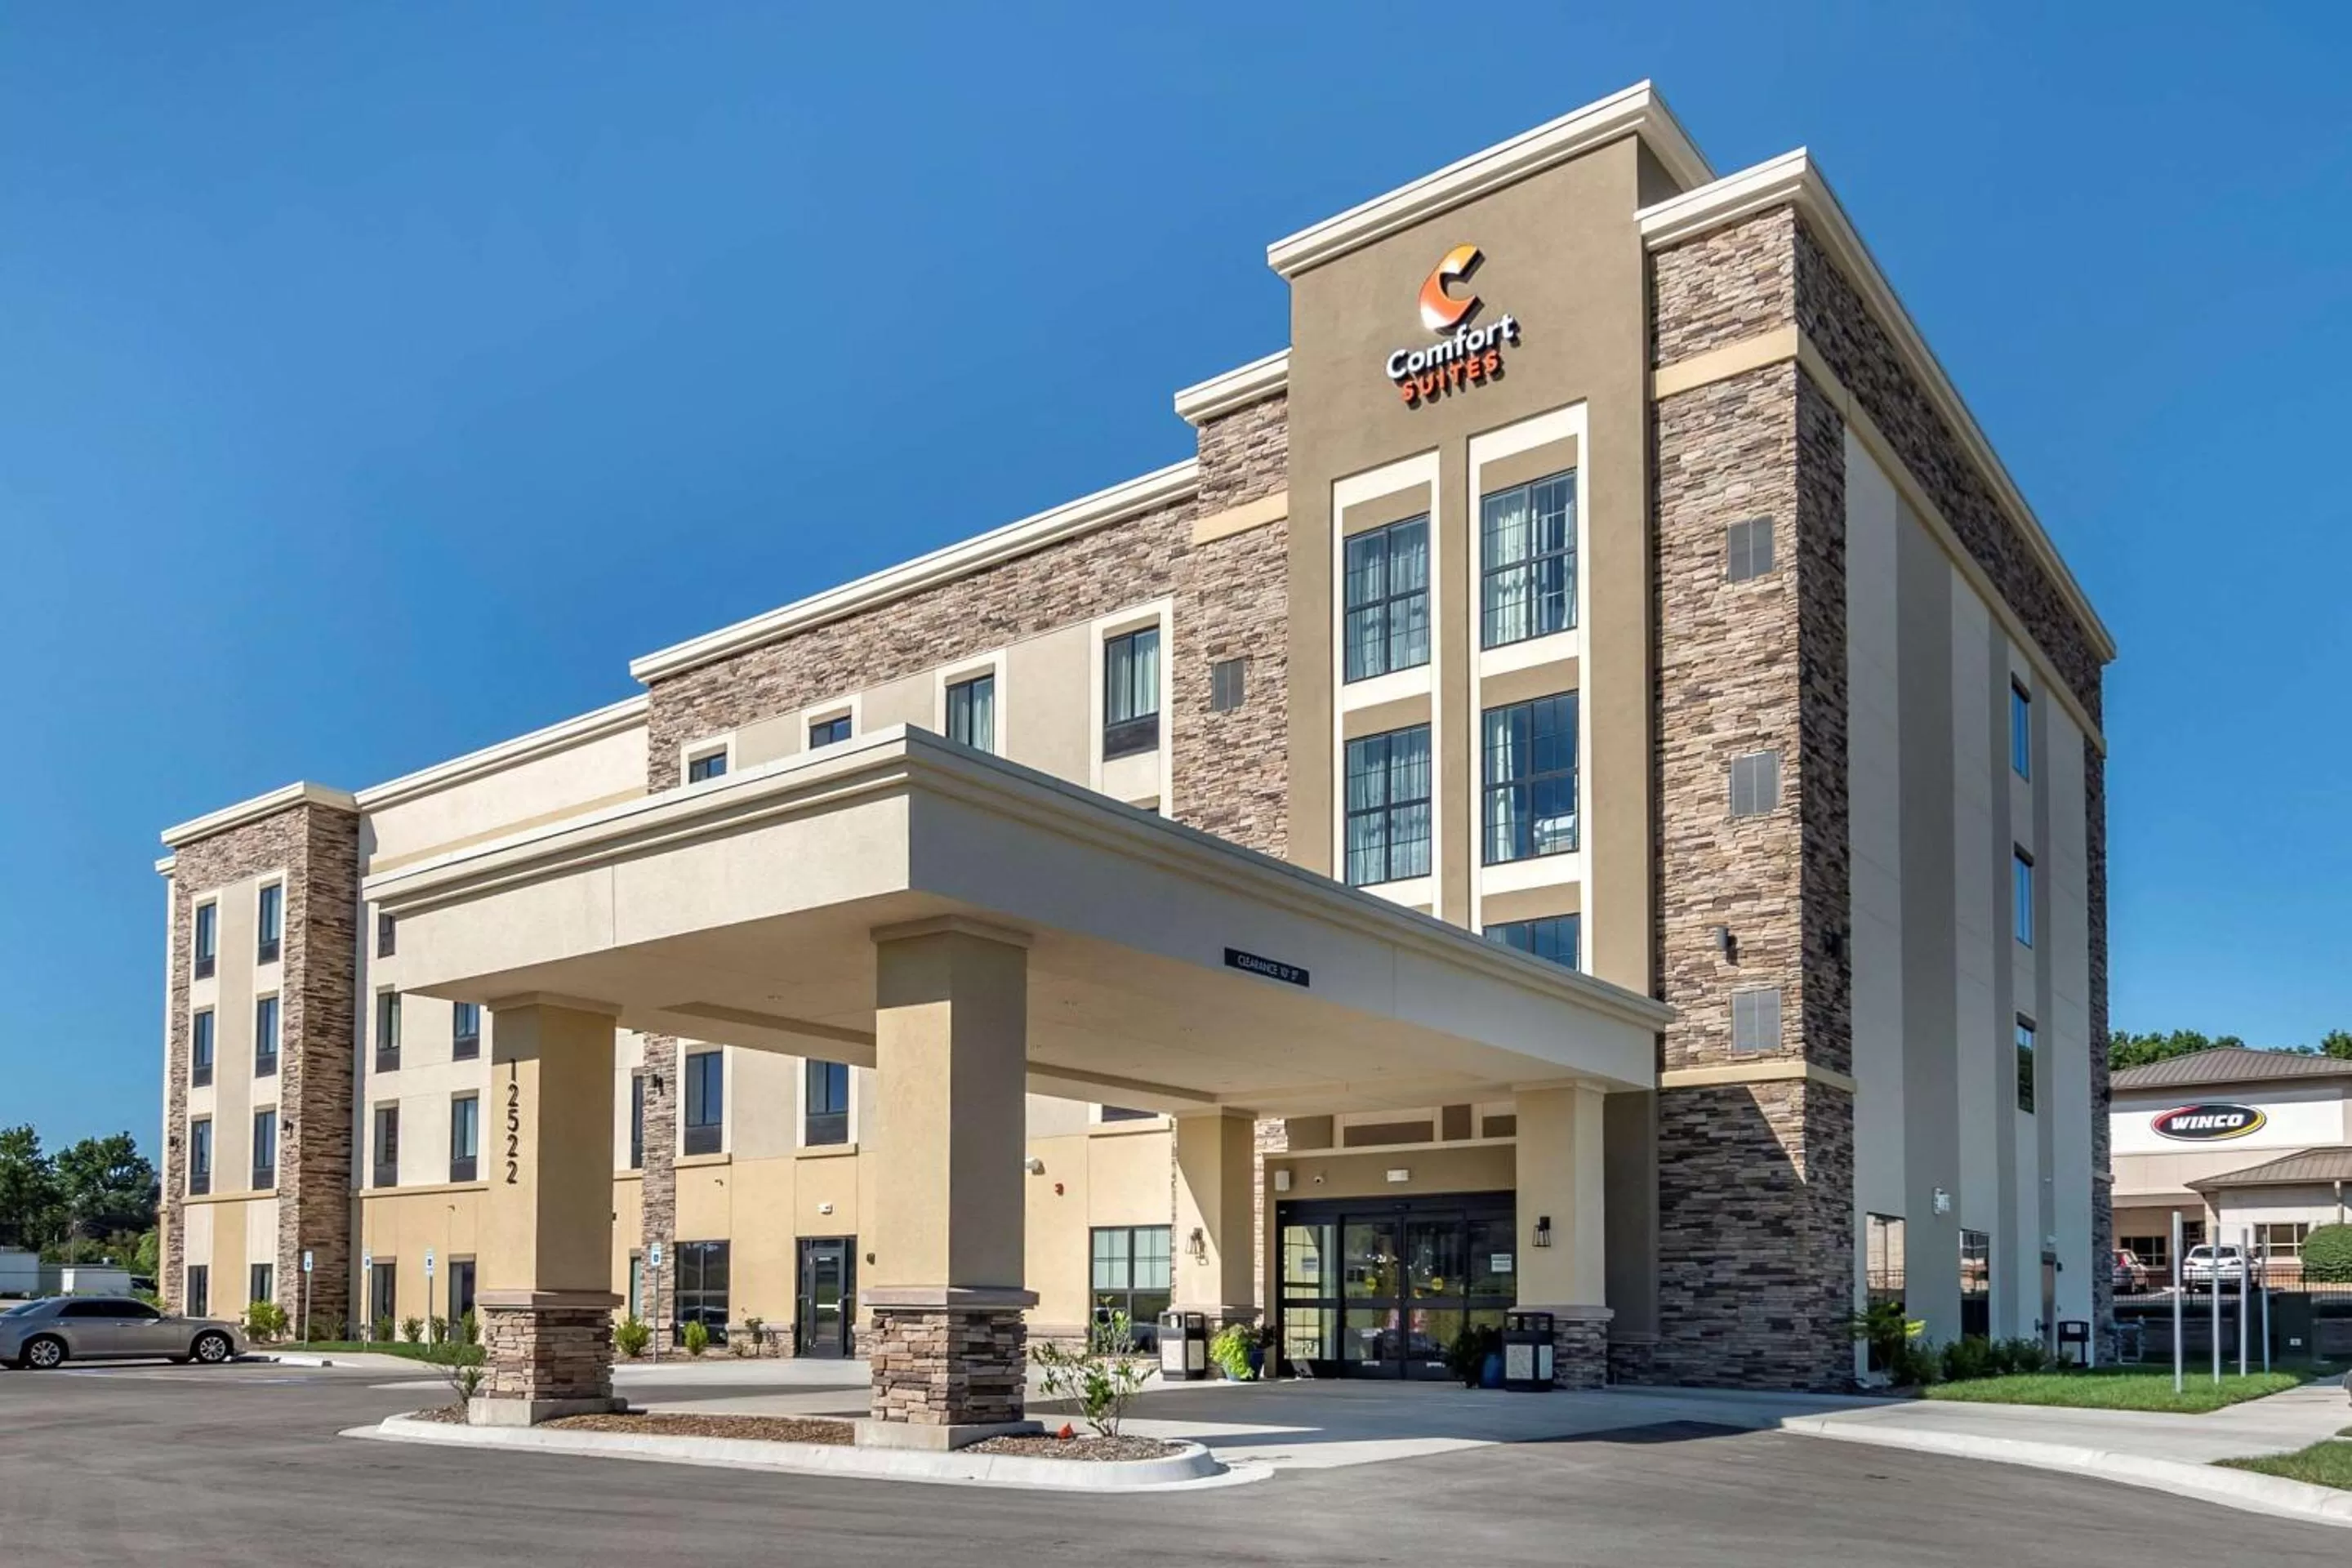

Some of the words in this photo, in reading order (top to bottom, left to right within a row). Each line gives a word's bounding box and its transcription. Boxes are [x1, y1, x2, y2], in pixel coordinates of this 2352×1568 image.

[1386, 313, 1514, 379] Comfort
[1401, 349, 1500, 403] SUITES
[506, 1058, 519, 1184] 12522
[2171, 1113, 2244, 1129] WINCO
